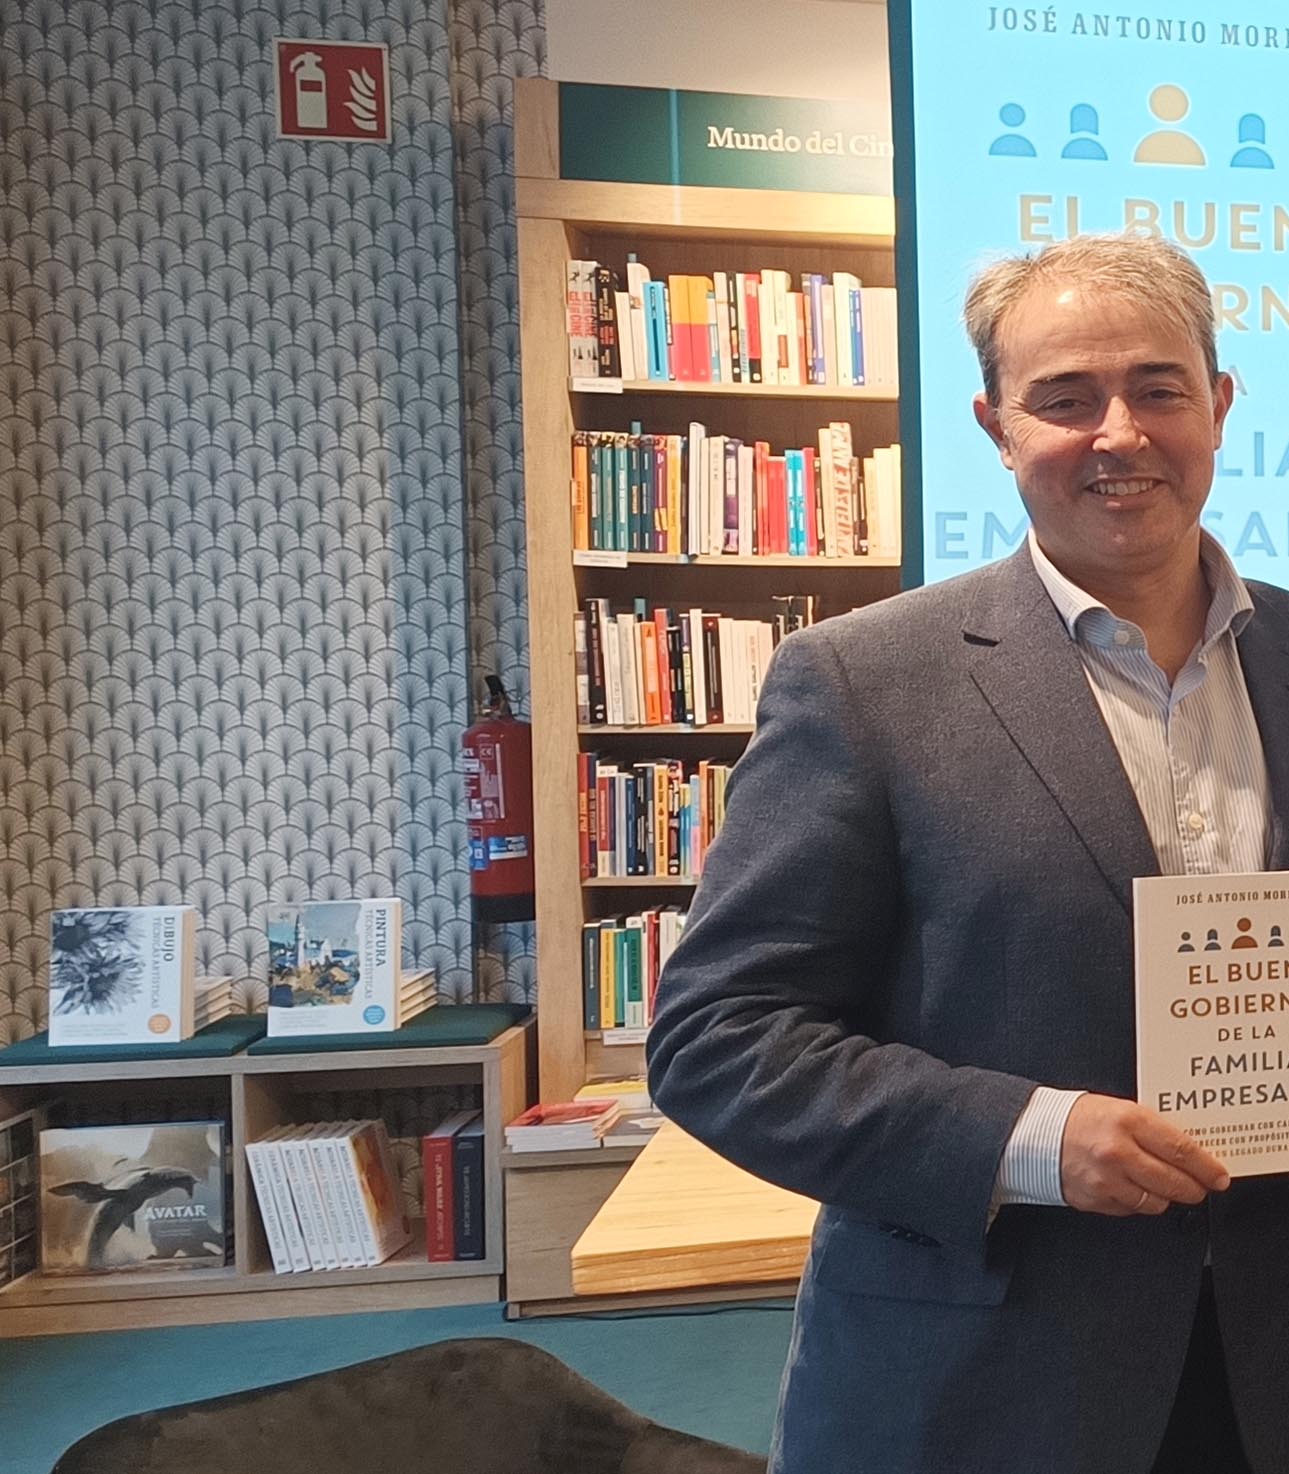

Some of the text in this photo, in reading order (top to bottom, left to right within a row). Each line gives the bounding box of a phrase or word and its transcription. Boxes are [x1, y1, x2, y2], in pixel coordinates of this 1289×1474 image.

[986, 6, 1058, 33] JOSÉ
[1071, 13, 1206, 44] ANTONIO
[707, 126, 894, 158] Mundo del Cin
[1176, 892, 1203, 905] JOSÉ
[1207, 891, 1259, 903] ANTONIO
[162, 916, 175, 962] DIBUJO
[375, 909, 387, 967] PINTURA
[1188, 965, 1219, 985] EL
[1218, 1025, 1276, 1042] DE LA
[1257, 1120, 1275, 1131] CON
[145, 1205, 206, 1219] AVATAR
